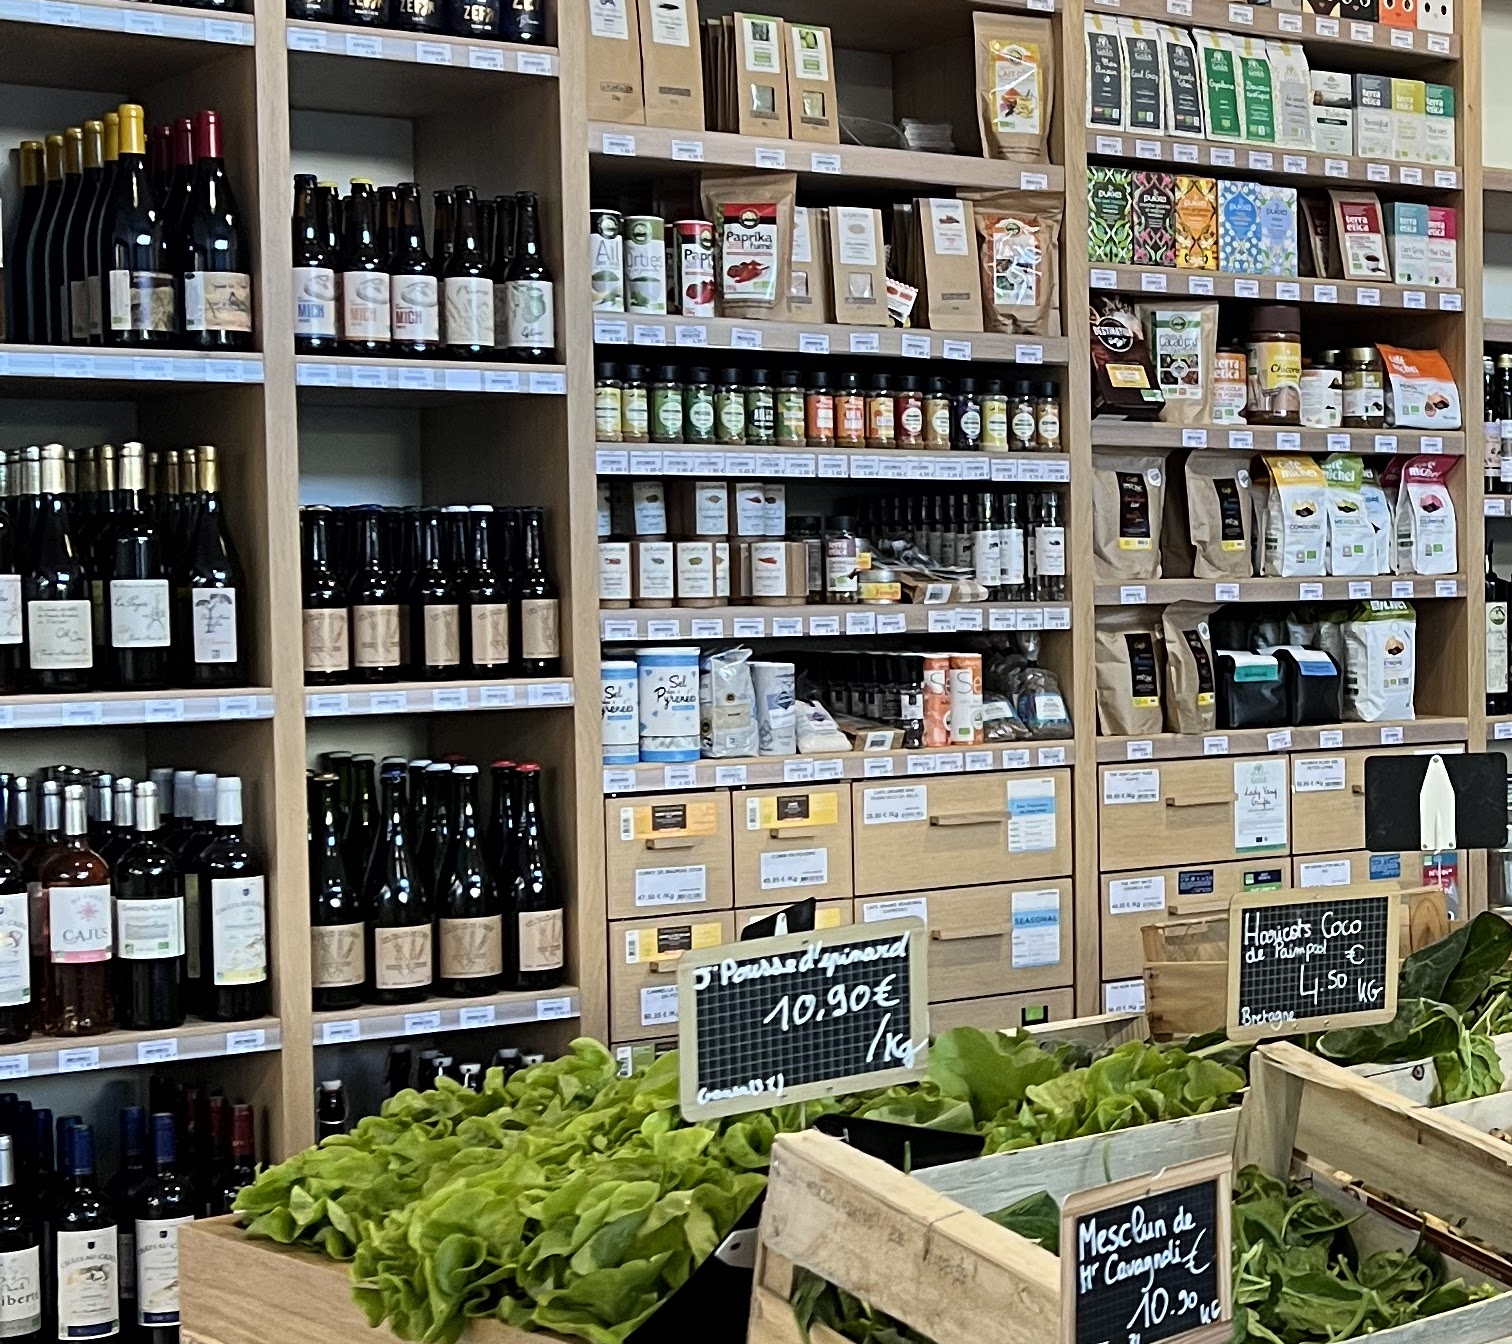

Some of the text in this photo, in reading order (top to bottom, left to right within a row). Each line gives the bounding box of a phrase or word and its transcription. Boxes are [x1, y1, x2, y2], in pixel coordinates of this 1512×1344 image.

[726, 231, 773, 248] Paprika
[596, 240, 620, 267] Ail
[684, 248, 713, 270] Papr
[604, 685, 623, 699] Sel
[668, 674, 687, 689] Sel
[956, 671, 982, 695] Se
[1014, 914, 1058, 926] SEASONAL
[1244, 910, 1362, 947] Haricots Coco
[62, 928, 108, 945] CAJUS
[1245, 938, 1328, 964] de Paimpol
[720, 958, 798, 986] Pousse
[1241, 1005, 1297, 1031] Bretagne
[1079, 1205, 1197, 1262] Mesclun de
